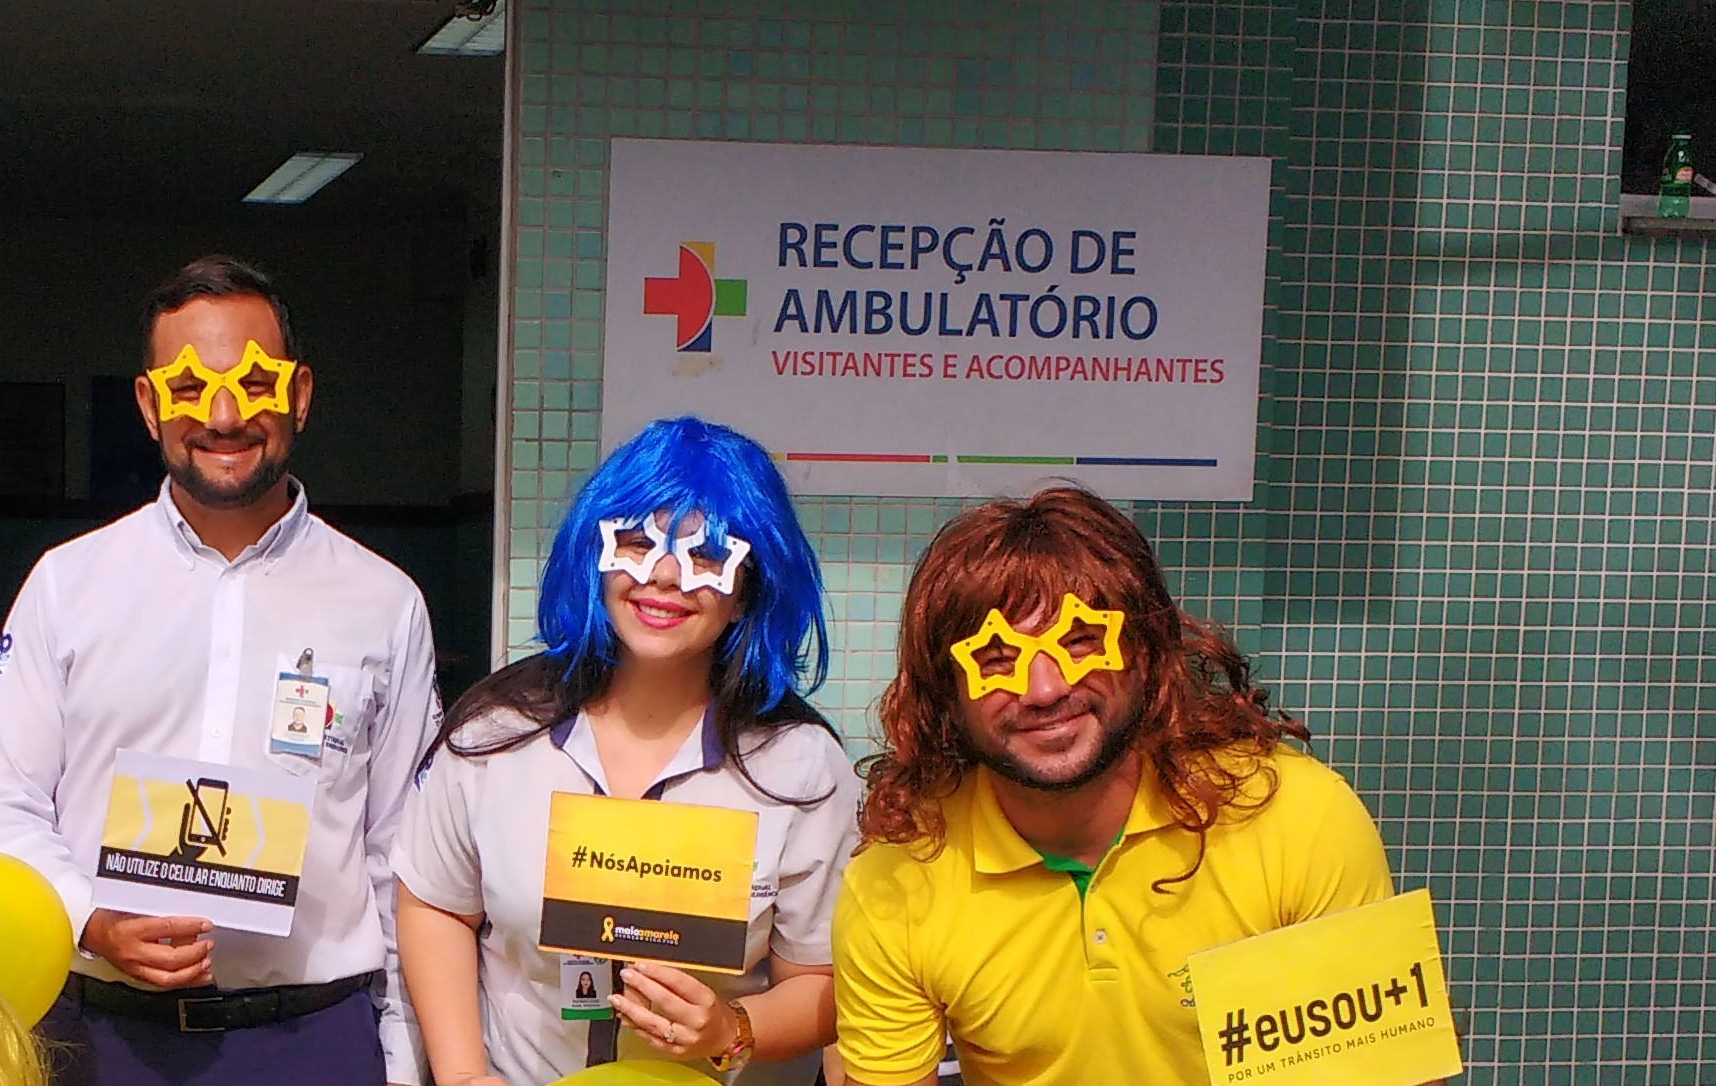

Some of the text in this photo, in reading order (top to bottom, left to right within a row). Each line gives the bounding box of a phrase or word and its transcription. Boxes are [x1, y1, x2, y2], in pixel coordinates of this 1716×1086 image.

[778, 218, 1137, 284] RECEPÇÃO DE
[773, 285, 1158, 340] AMBULATÓRIO
[771, 350, 1225, 384] VISITANTES E ACOMPANHANTES
[105, 853, 286, 897] NÃO UTILIZE O CELULAR ENQUANTO DIRIGE
[571, 845, 722, 883] #NósApoiamos
[1218, 961, 1428, 1066] #eusou+1
[1228, 1069, 1253, 1083] POR
[1257, 1062, 1276, 1076] UM
[1346, 1032, 1376, 1050] MAIS
[1380, 1016, 1436, 1041] HUMANO
